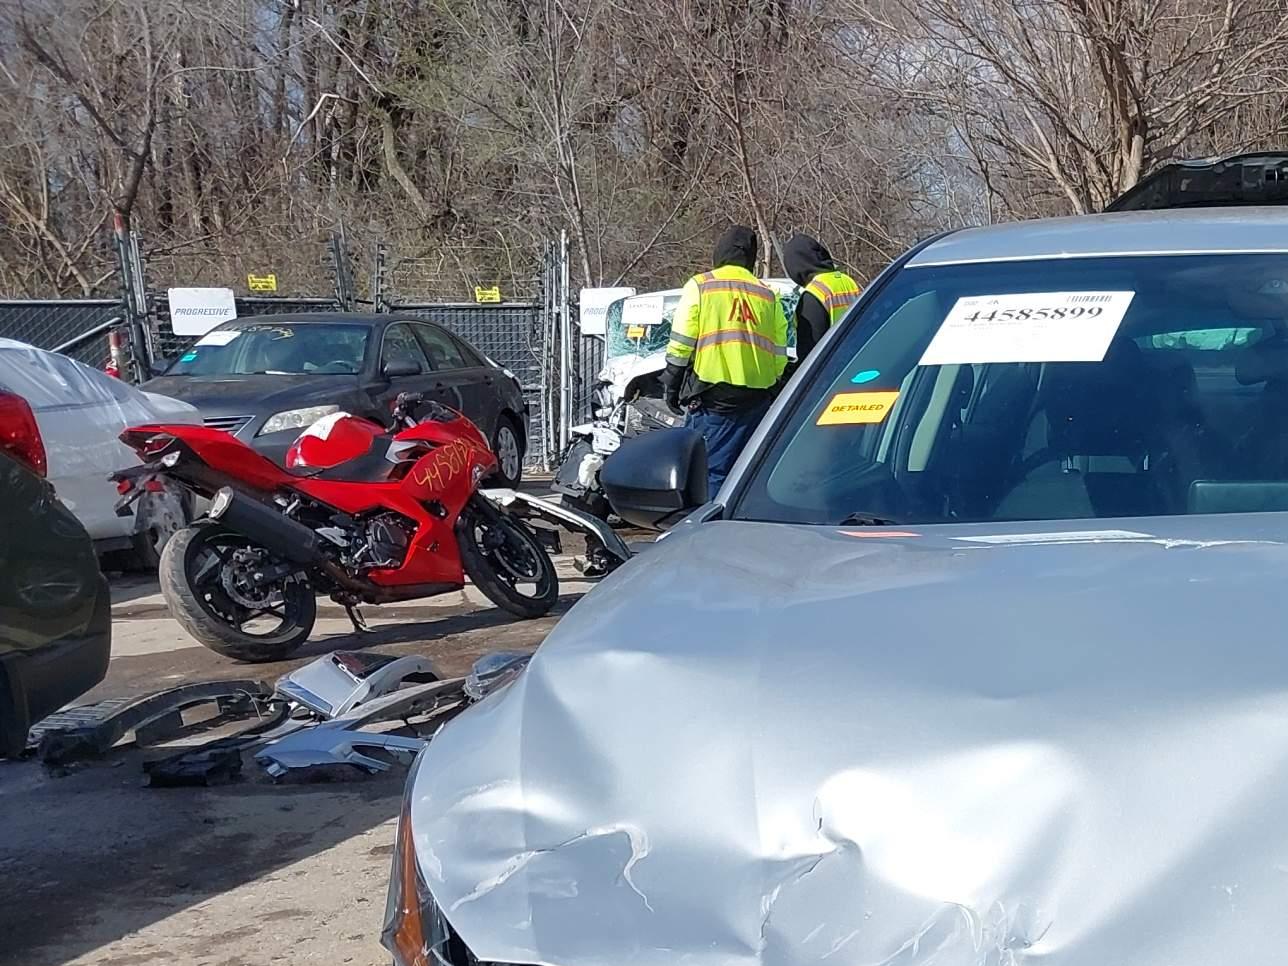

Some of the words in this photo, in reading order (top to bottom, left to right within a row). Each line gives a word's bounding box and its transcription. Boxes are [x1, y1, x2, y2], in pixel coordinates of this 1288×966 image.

[175, 308, 232, 316] PROGRESSIVE
[963, 306, 1104, 323] 44585899
[831, 404, 885, 413] DETAILED
